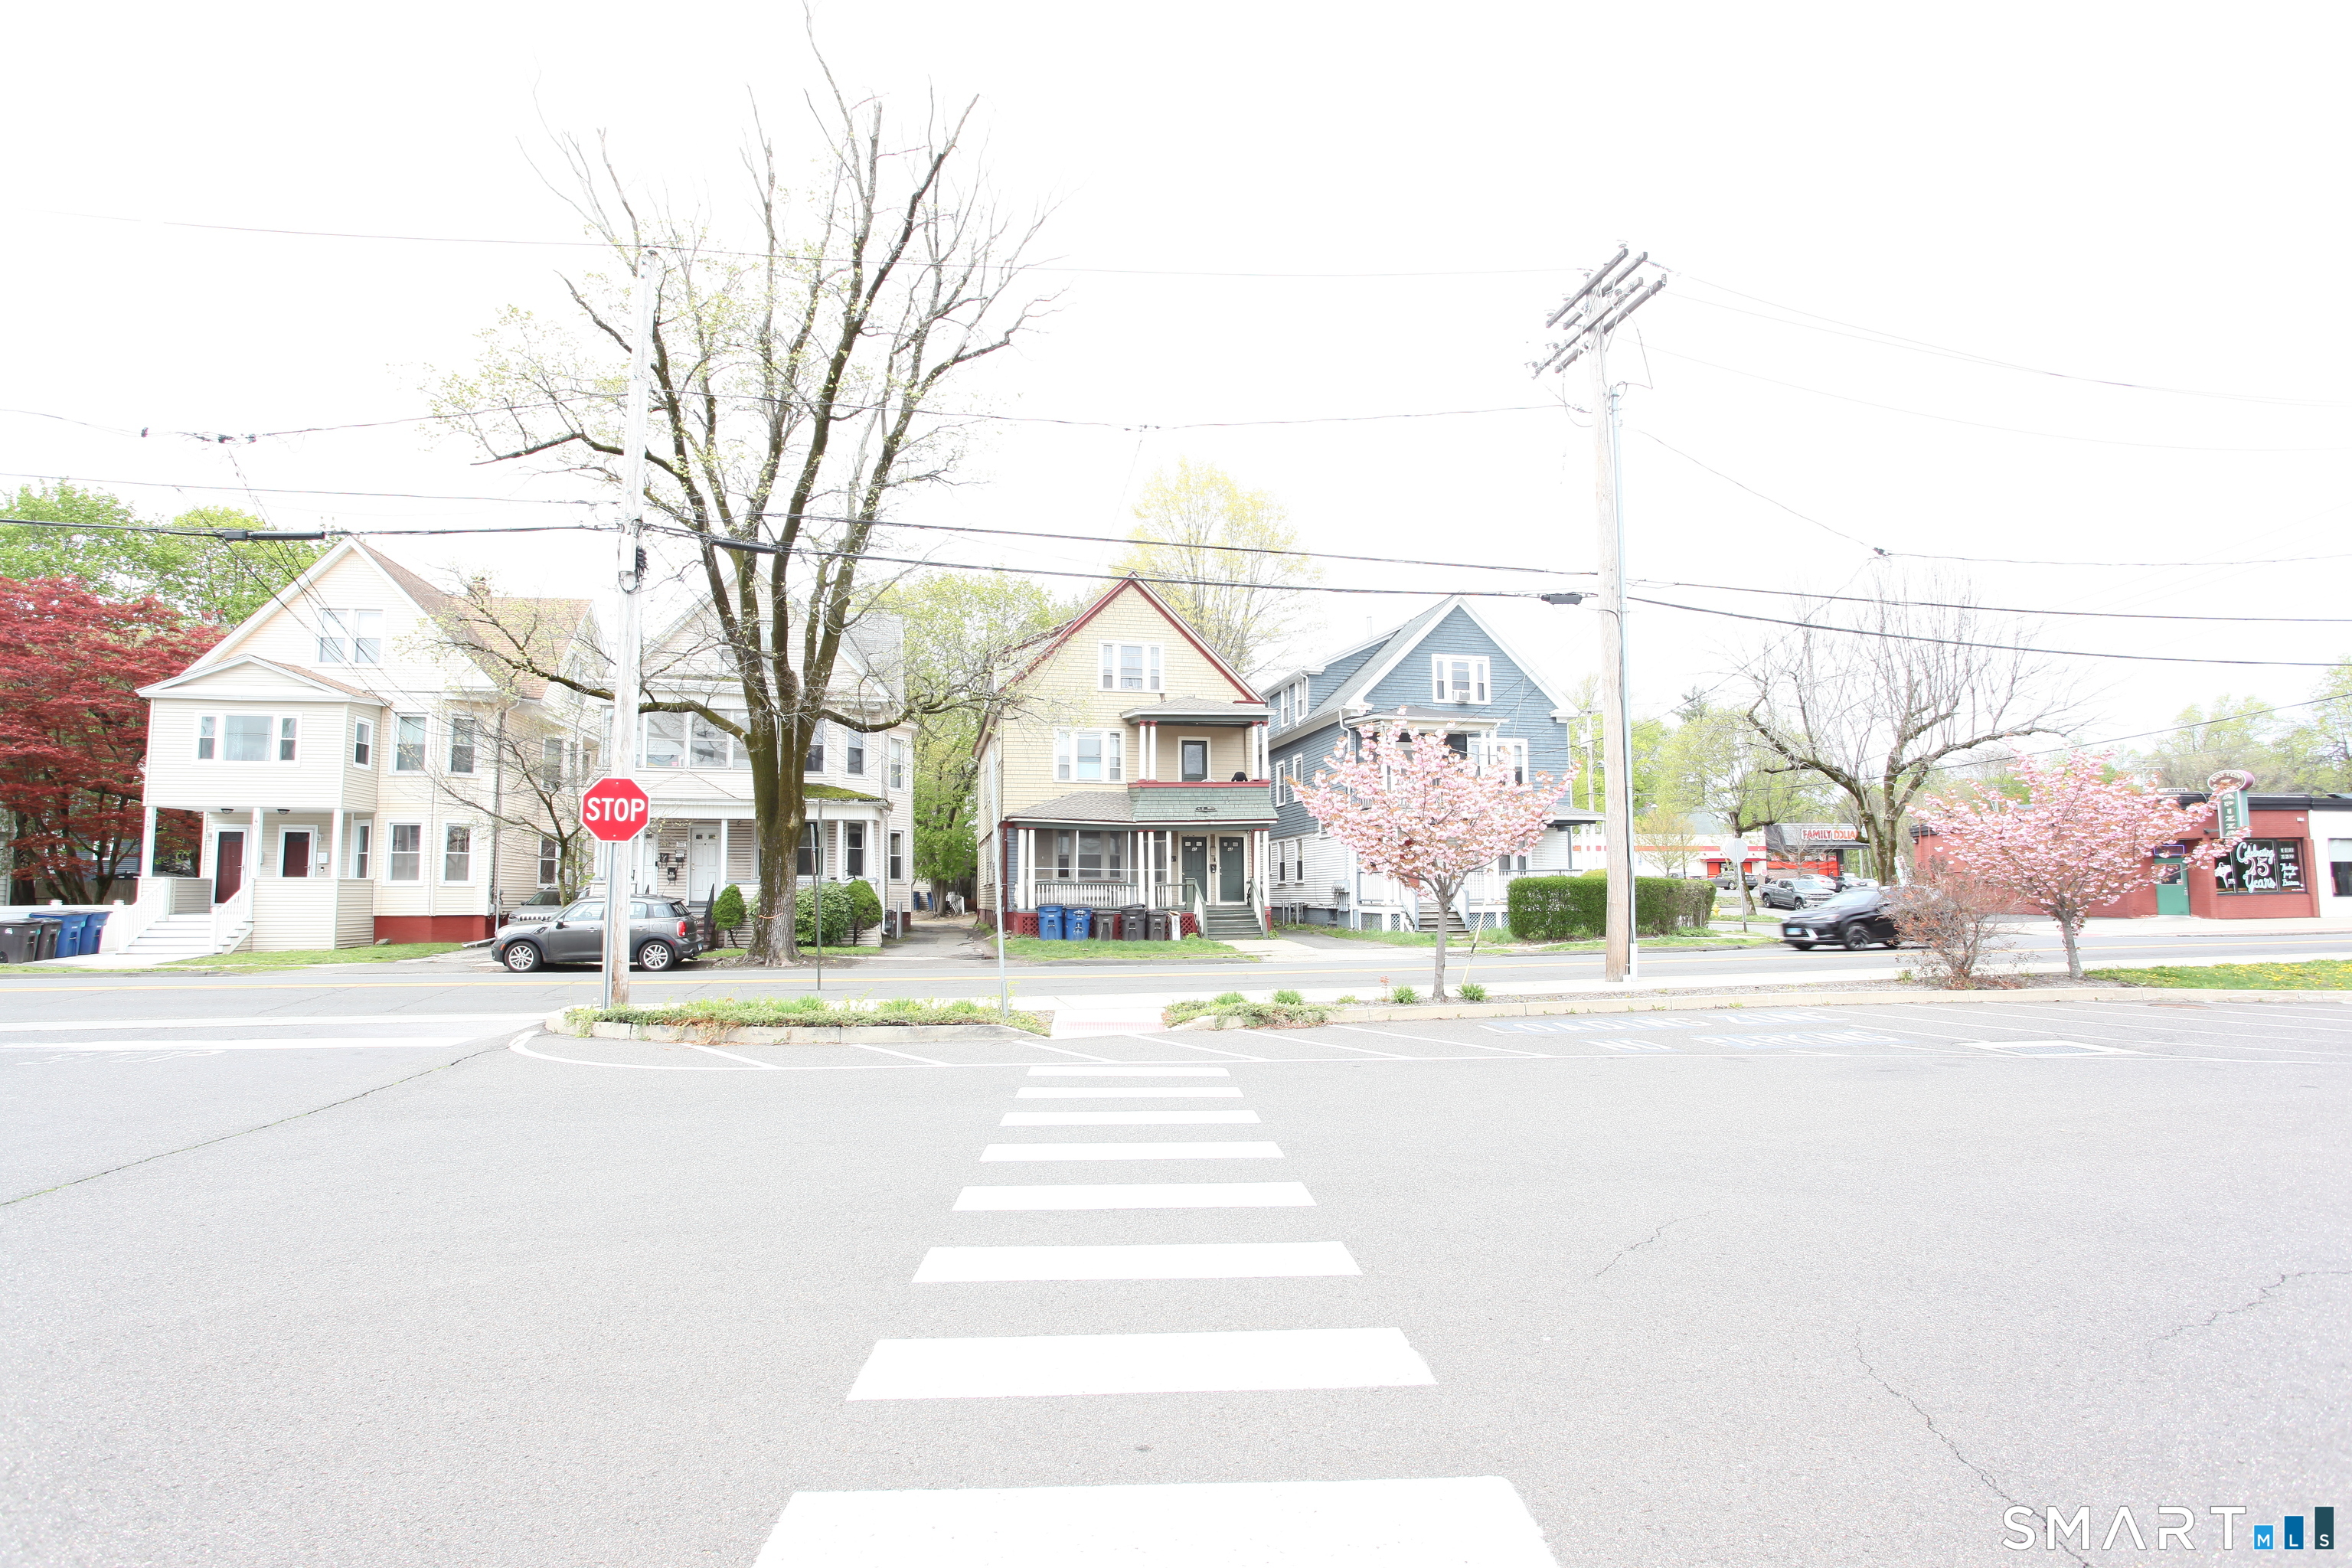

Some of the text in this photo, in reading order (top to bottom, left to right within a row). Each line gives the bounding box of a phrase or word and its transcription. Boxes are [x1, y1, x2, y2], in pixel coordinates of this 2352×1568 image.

[586, 797, 645, 822] STOP
[2222, 793, 2236, 837] APIZZA
[146, 816, 151, 831] 38
[254, 817, 259, 831] 40
[1802, 830, 1859, 839] FAMILY DOLLA
[2244, 858, 2269, 876] 25
[2243, 874, 2276, 893] Years
[1478, 1011, 1851, 1034] LOADING ZONE
[1584, 1031, 1903, 1051] NO PARKING
